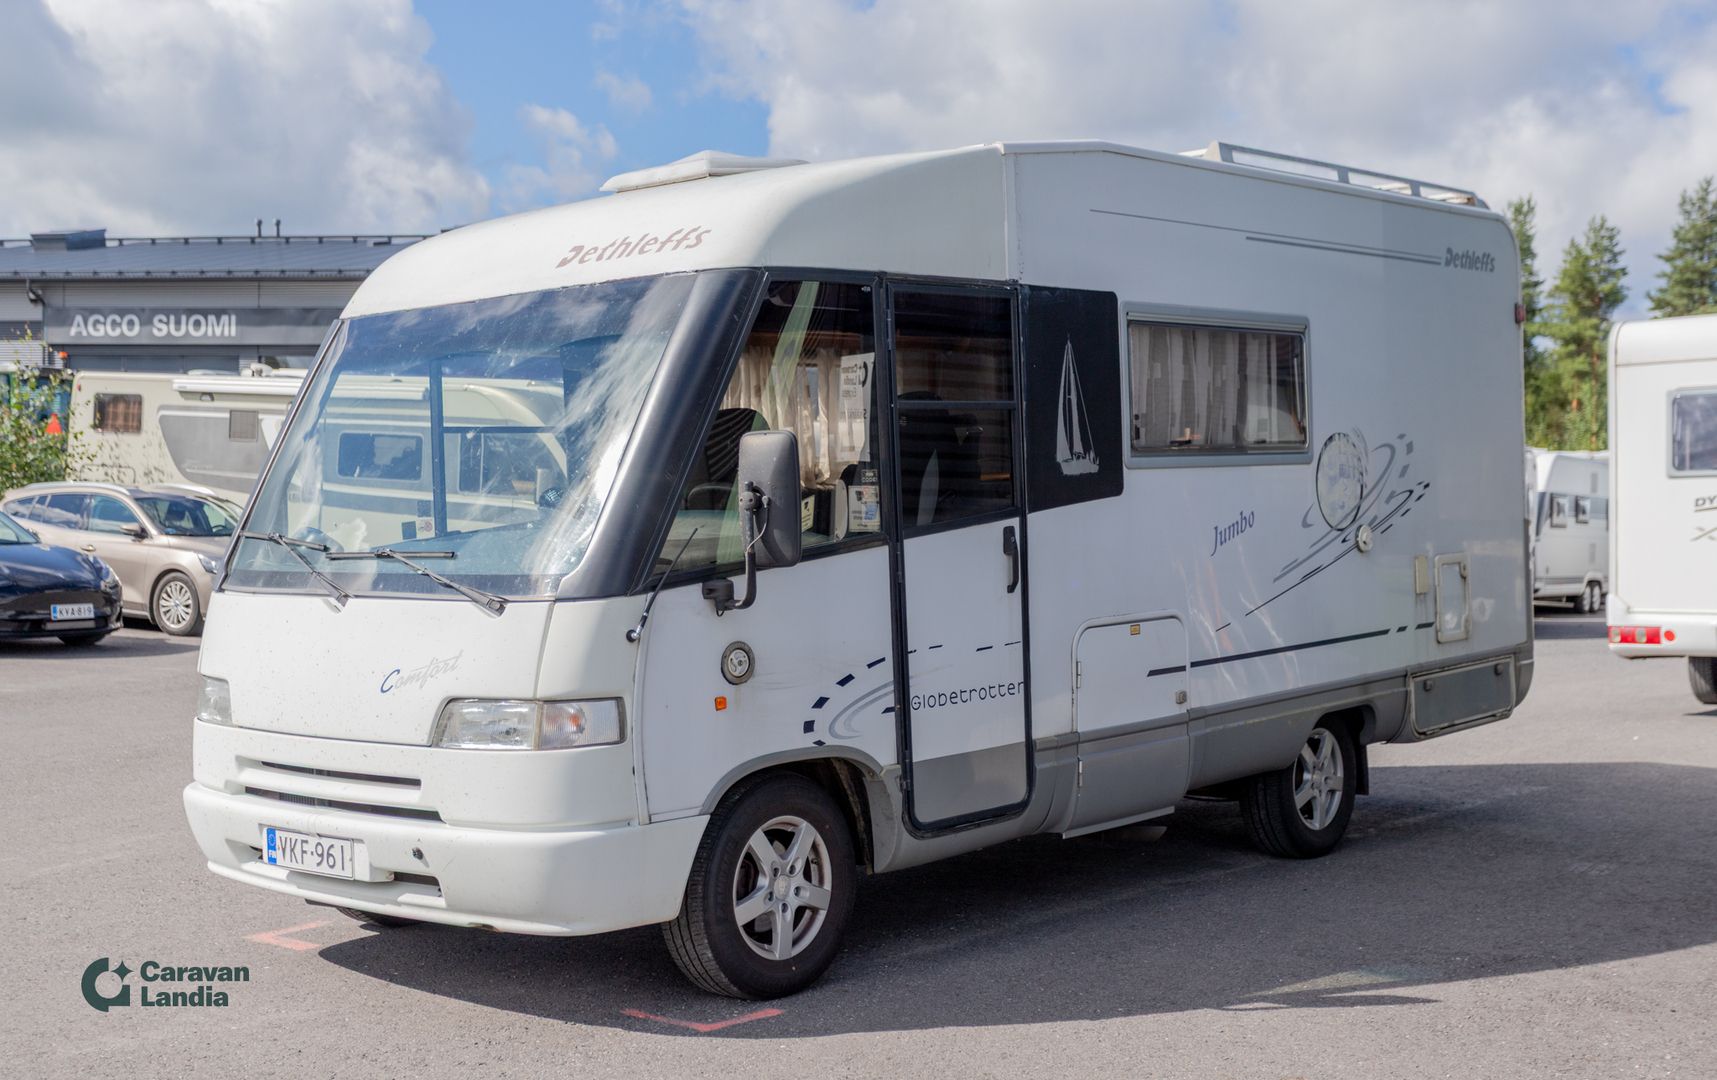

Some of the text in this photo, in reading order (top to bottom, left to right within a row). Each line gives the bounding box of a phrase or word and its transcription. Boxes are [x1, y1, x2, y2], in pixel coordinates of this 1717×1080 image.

[556, 225, 712, 268] Dethleffs
[1445, 246, 1495, 272] Dethleffs
[69, 313, 237, 338] AGCO SUOMI
[1210, 510, 1255, 557] Jumbo
[380, 649, 464, 693] Comfort
[910, 681, 1024, 711] Globetrotter
